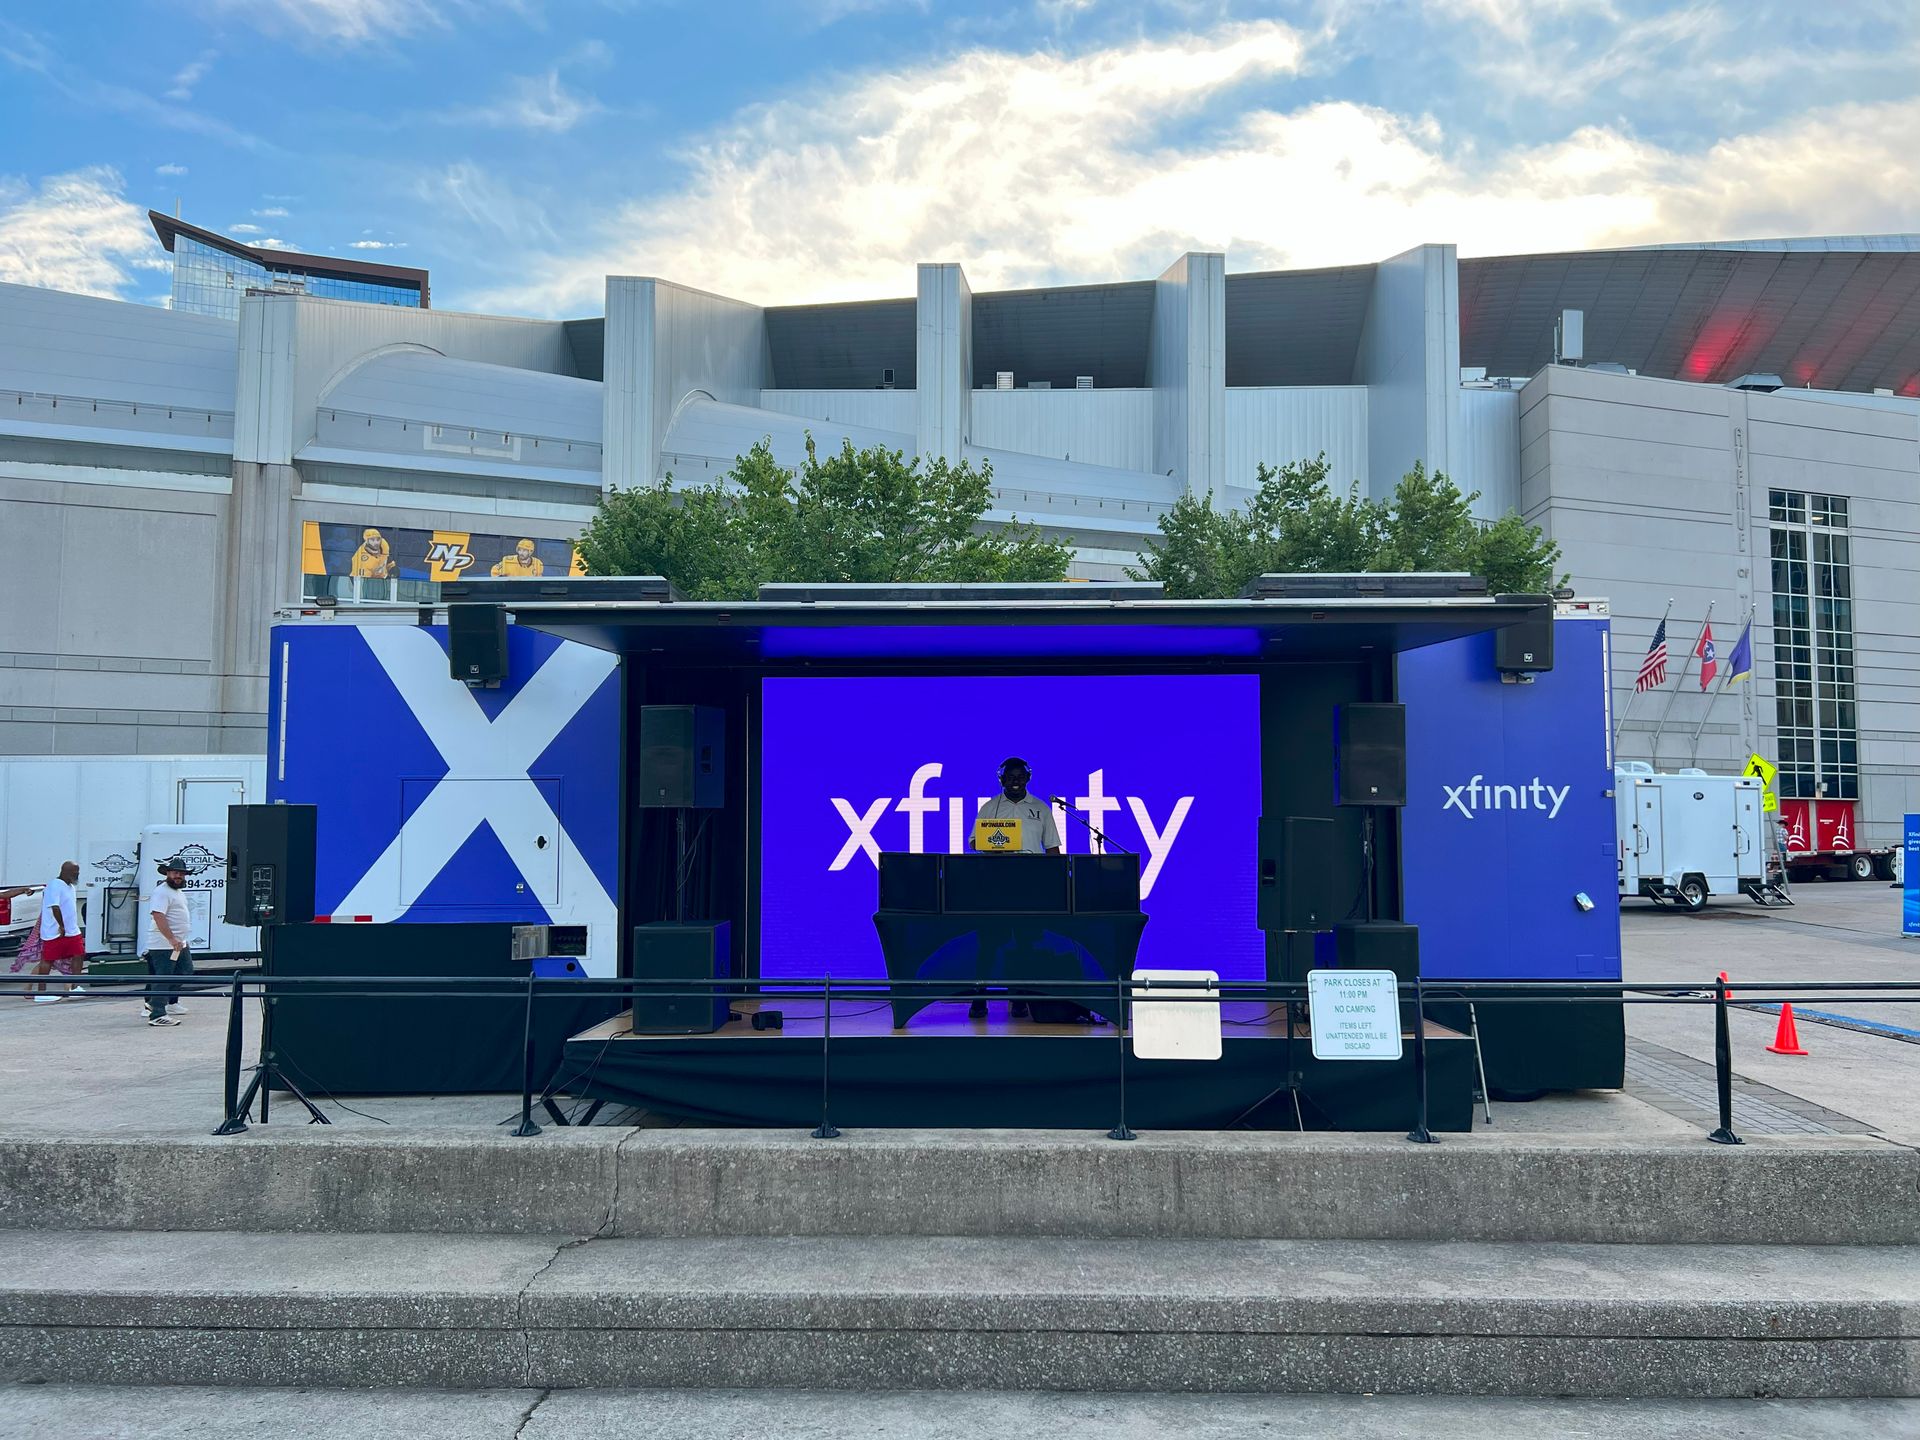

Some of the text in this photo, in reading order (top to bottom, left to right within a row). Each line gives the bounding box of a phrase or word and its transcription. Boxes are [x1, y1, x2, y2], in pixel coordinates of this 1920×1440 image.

[1442, 775, 1571, 819] xfinity
[1027, 808, 1040, 819] M
[173, 856, 212, 864] FICIAL
[1324, 979, 1381, 987] PARK CLOSES AT
[1340, 990, 1367, 998] 11:00 PM
[1335, 1005, 1376, 1013] NO CAMPING
